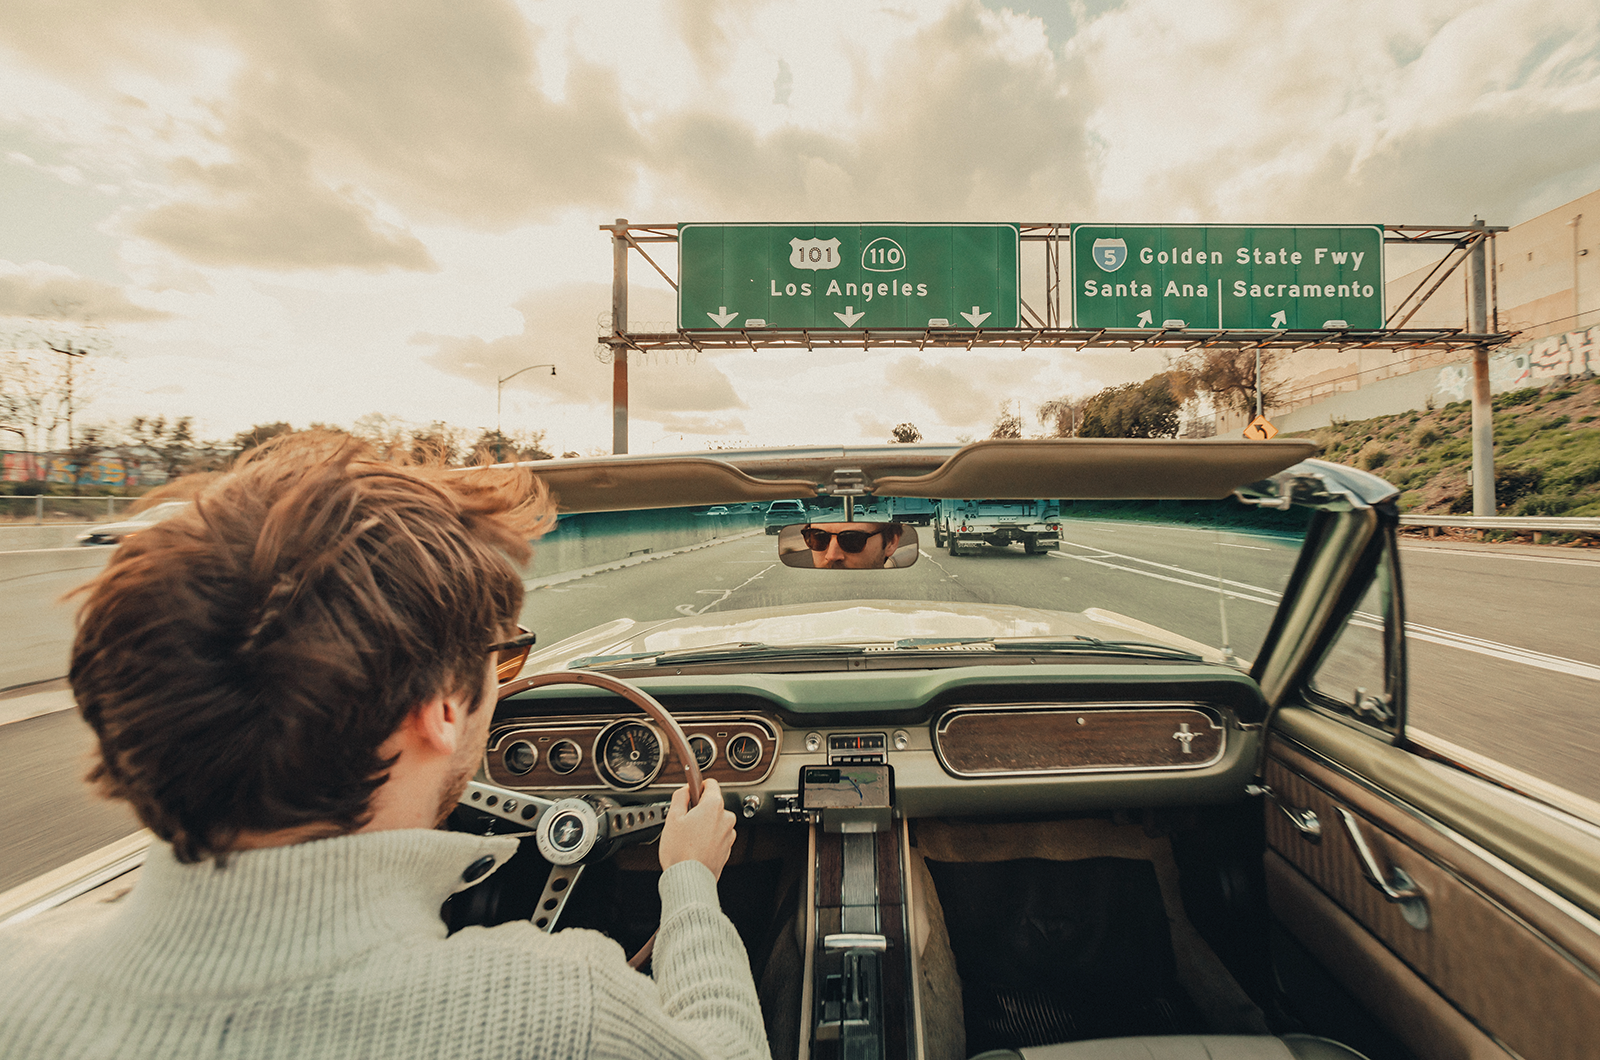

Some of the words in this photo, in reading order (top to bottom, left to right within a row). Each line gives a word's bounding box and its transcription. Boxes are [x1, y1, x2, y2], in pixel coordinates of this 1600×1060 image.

[798, 246, 832, 263] 101
[869, 248, 901, 264] 110
[1104, 249, 1117, 266] 5
[1139, 247, 1223, 265] Golden
[1236, 247, 1303, 265] State
[1314, 247, 1365, 271] Fwy
[770, 279, 812, 297] Los
[825, 279, 928, 302] Angeles
[1084, 279, 1152, 298] Santa
[1163, 280, 1208, 298] Ana
[1232, 280, 1374, 298] Sacramento
